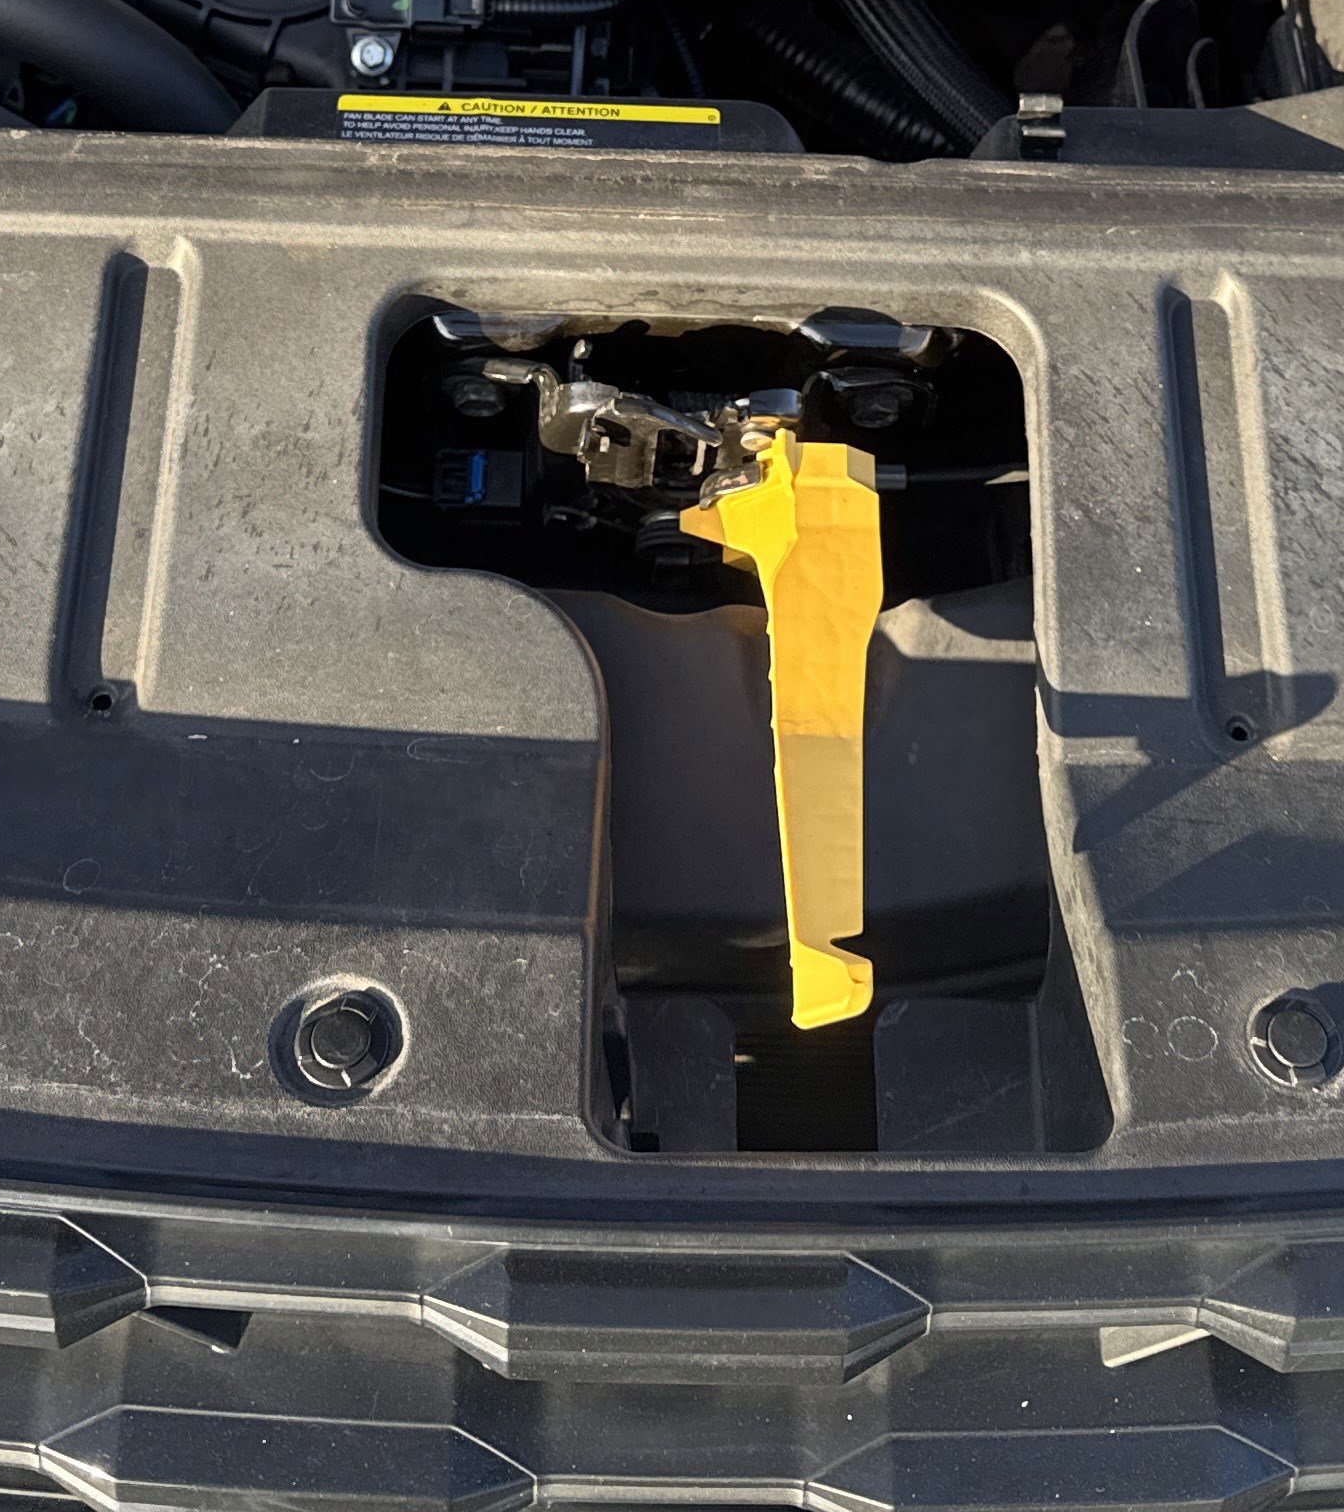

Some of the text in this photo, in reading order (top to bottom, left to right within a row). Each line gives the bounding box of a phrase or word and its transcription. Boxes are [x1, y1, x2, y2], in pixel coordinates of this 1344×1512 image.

[461, 102, 526, 114] CAUTION
[541, 104, 621, 118] ATTENTION
[395, 114, 416, 122] CAN
[343, 120, 355, 129] TO
